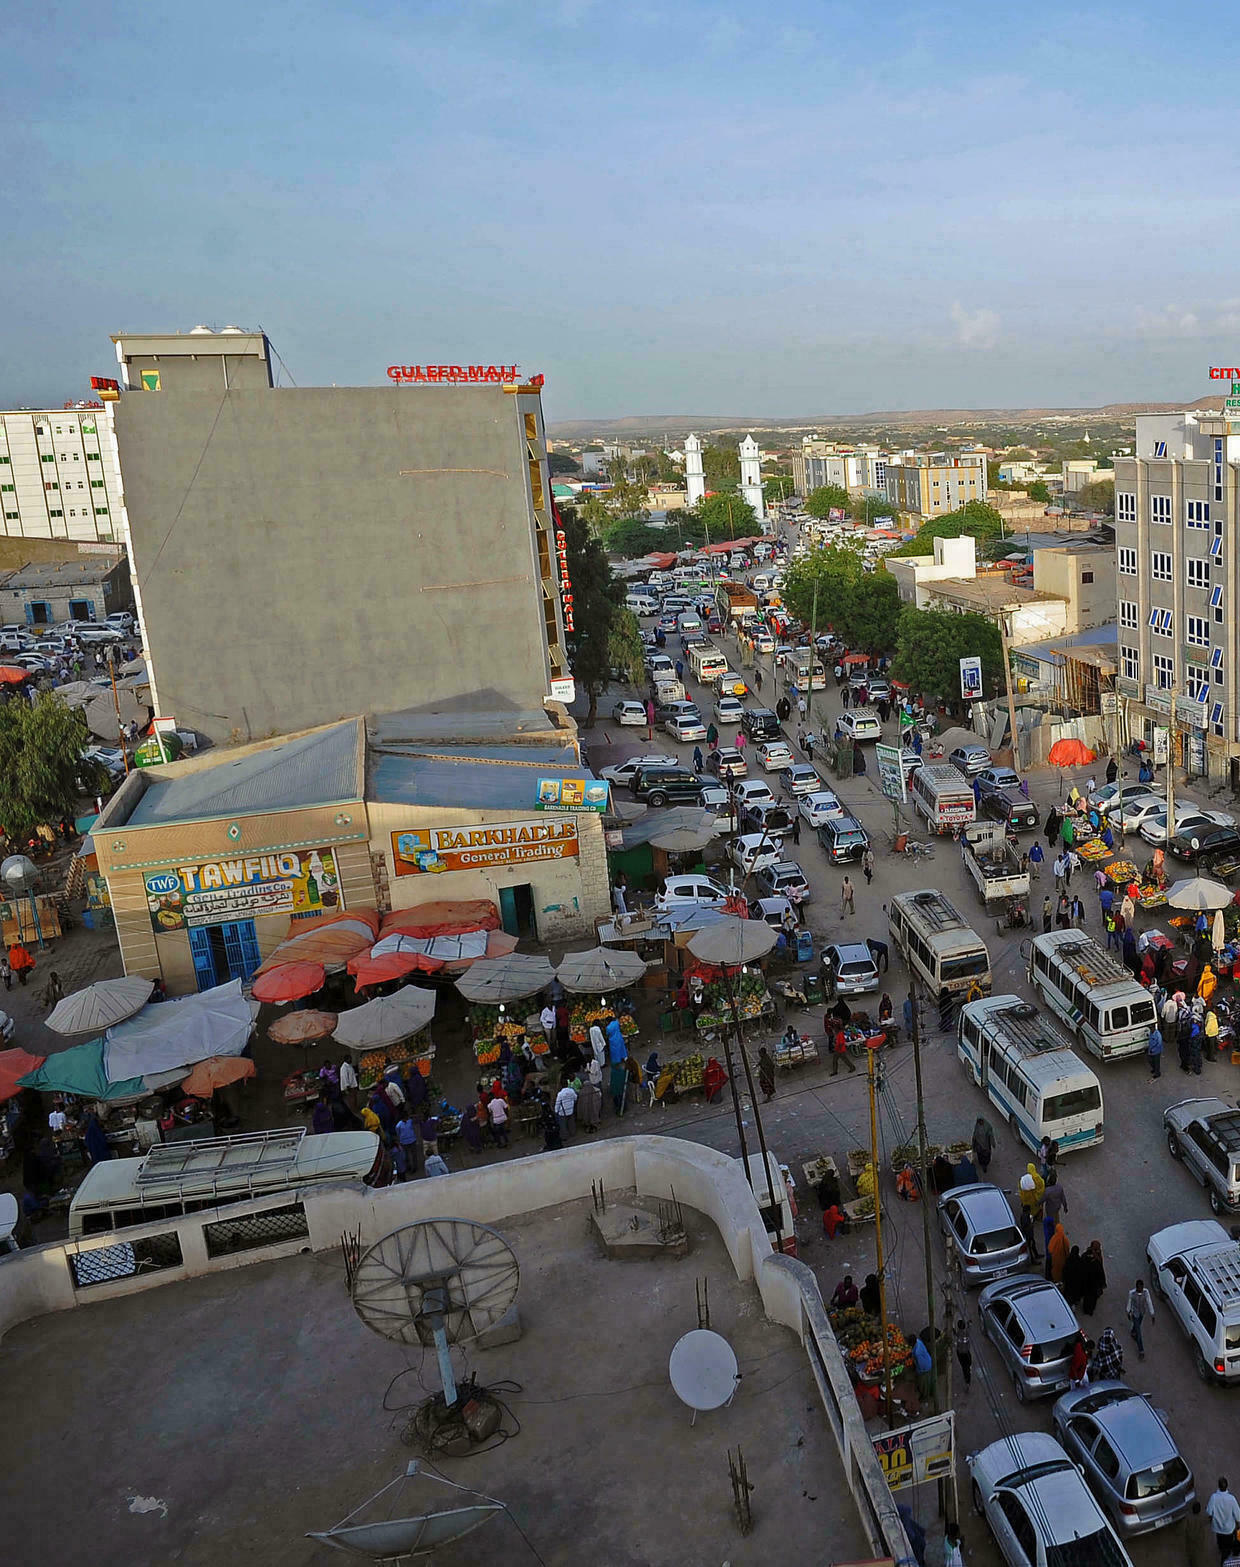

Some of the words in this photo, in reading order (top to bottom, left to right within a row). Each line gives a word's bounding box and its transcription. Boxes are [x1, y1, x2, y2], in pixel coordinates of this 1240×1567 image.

[387, 365, 462, 379] GULEED
[556, 530, 572, 589] GULEED
[436, 822, 577, 850] BARKHADLE
[461, 848, 510, 864] General
[511, 842, 566, 860] Trading
[149, 874, 175, 890] TWF
[178, 852, 303, 892] TAWFIIQ
